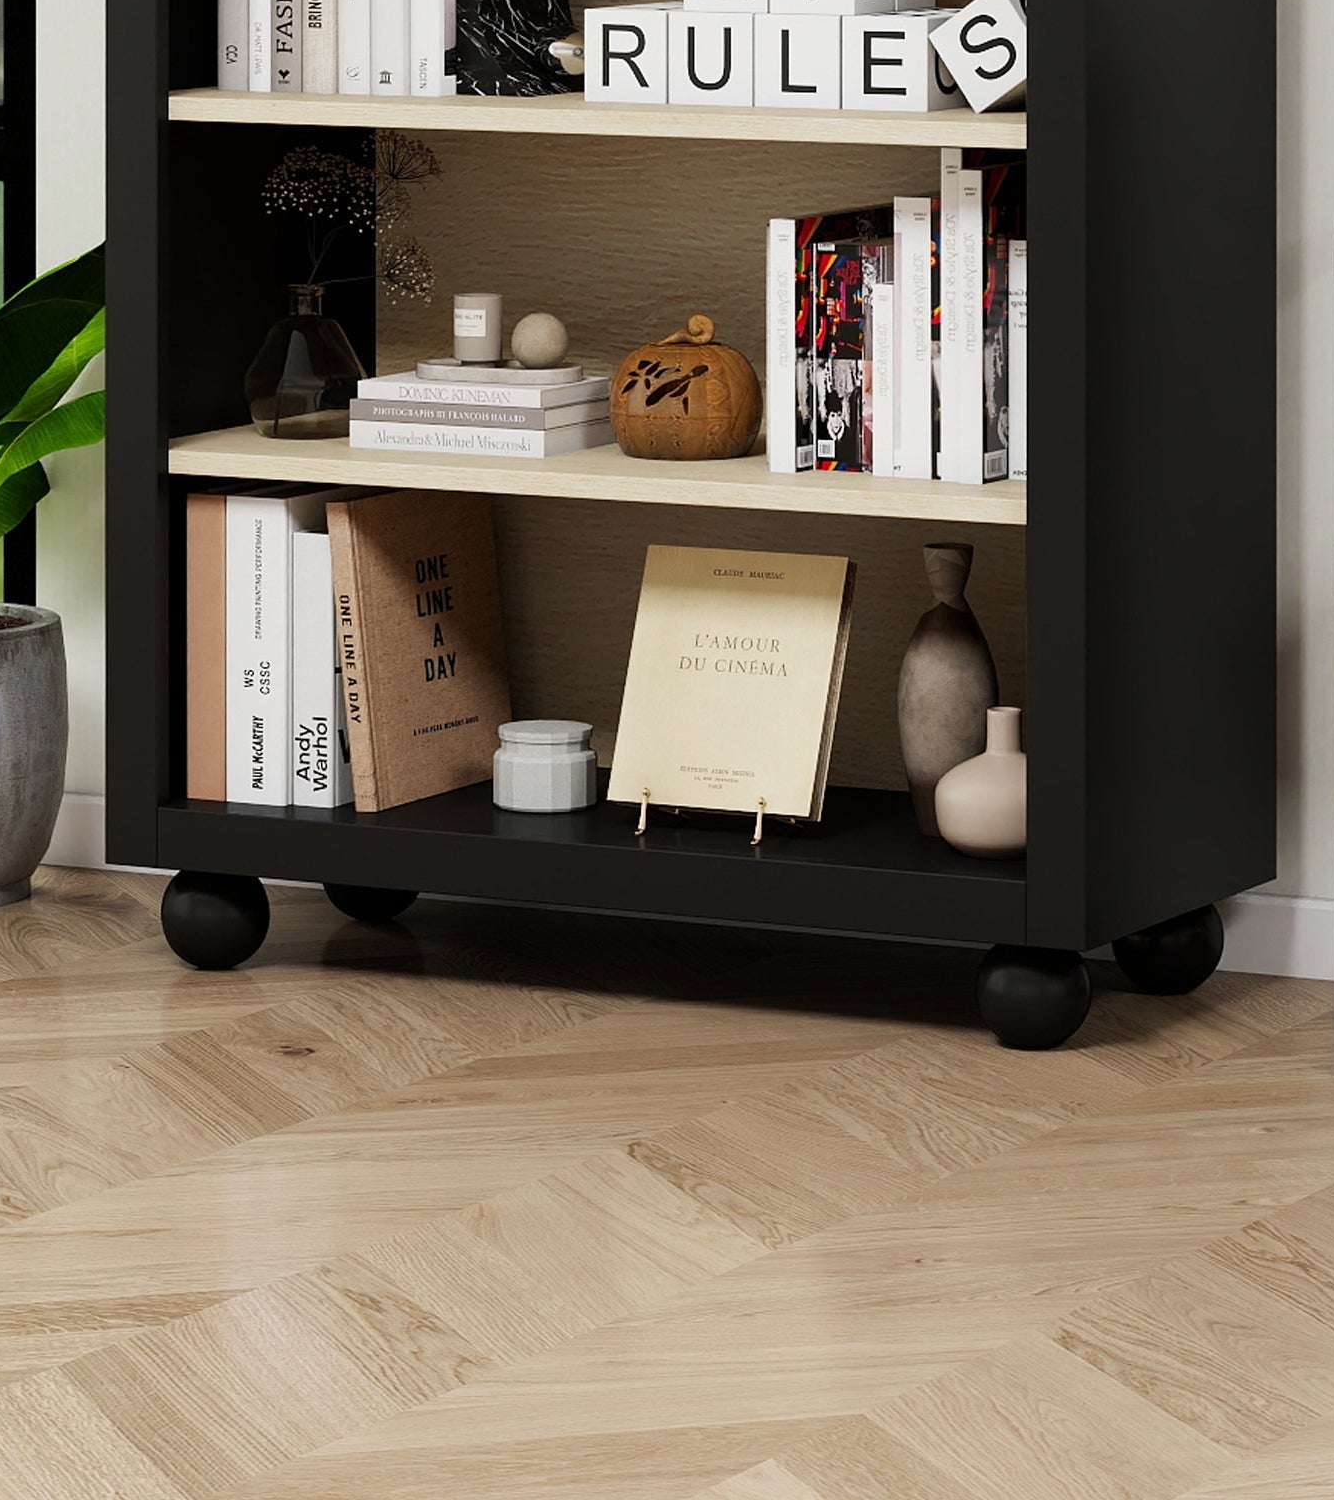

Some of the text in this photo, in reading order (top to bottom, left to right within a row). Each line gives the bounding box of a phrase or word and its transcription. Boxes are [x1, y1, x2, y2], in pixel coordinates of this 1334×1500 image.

[226, 44, 238, 65] CCA
[602, 14, 1017, 96] RULES
[399, 386, 449, 401] DOMINIC
[373, 407, 434, 419] PHOTOGRAPHS
[448, 411, 489, 422] FRANÇOIS
[374, 430, 424, 446] Alexandra
[435, 432, 475, 449] Michael
[415, 553, 449, 584] ONE
[416, 586, 454, 617] LINE
[433, 622, 444, 648] A
[695, 633, 780, 653] L'AMOUR
[339, 594, 362, 724] ONE LINE A DAY
[424, 651, 457, 682] DAY
[679, 656, 707, 671] DU
[244, 669, 255, 688] WS
[259, 661, 271, 695] CSSC
[252, 715, 264, 790] PAUL McCARTHY
[295, 724, 315, 781] Andy
[312, 717, 328, 792] Warhol
